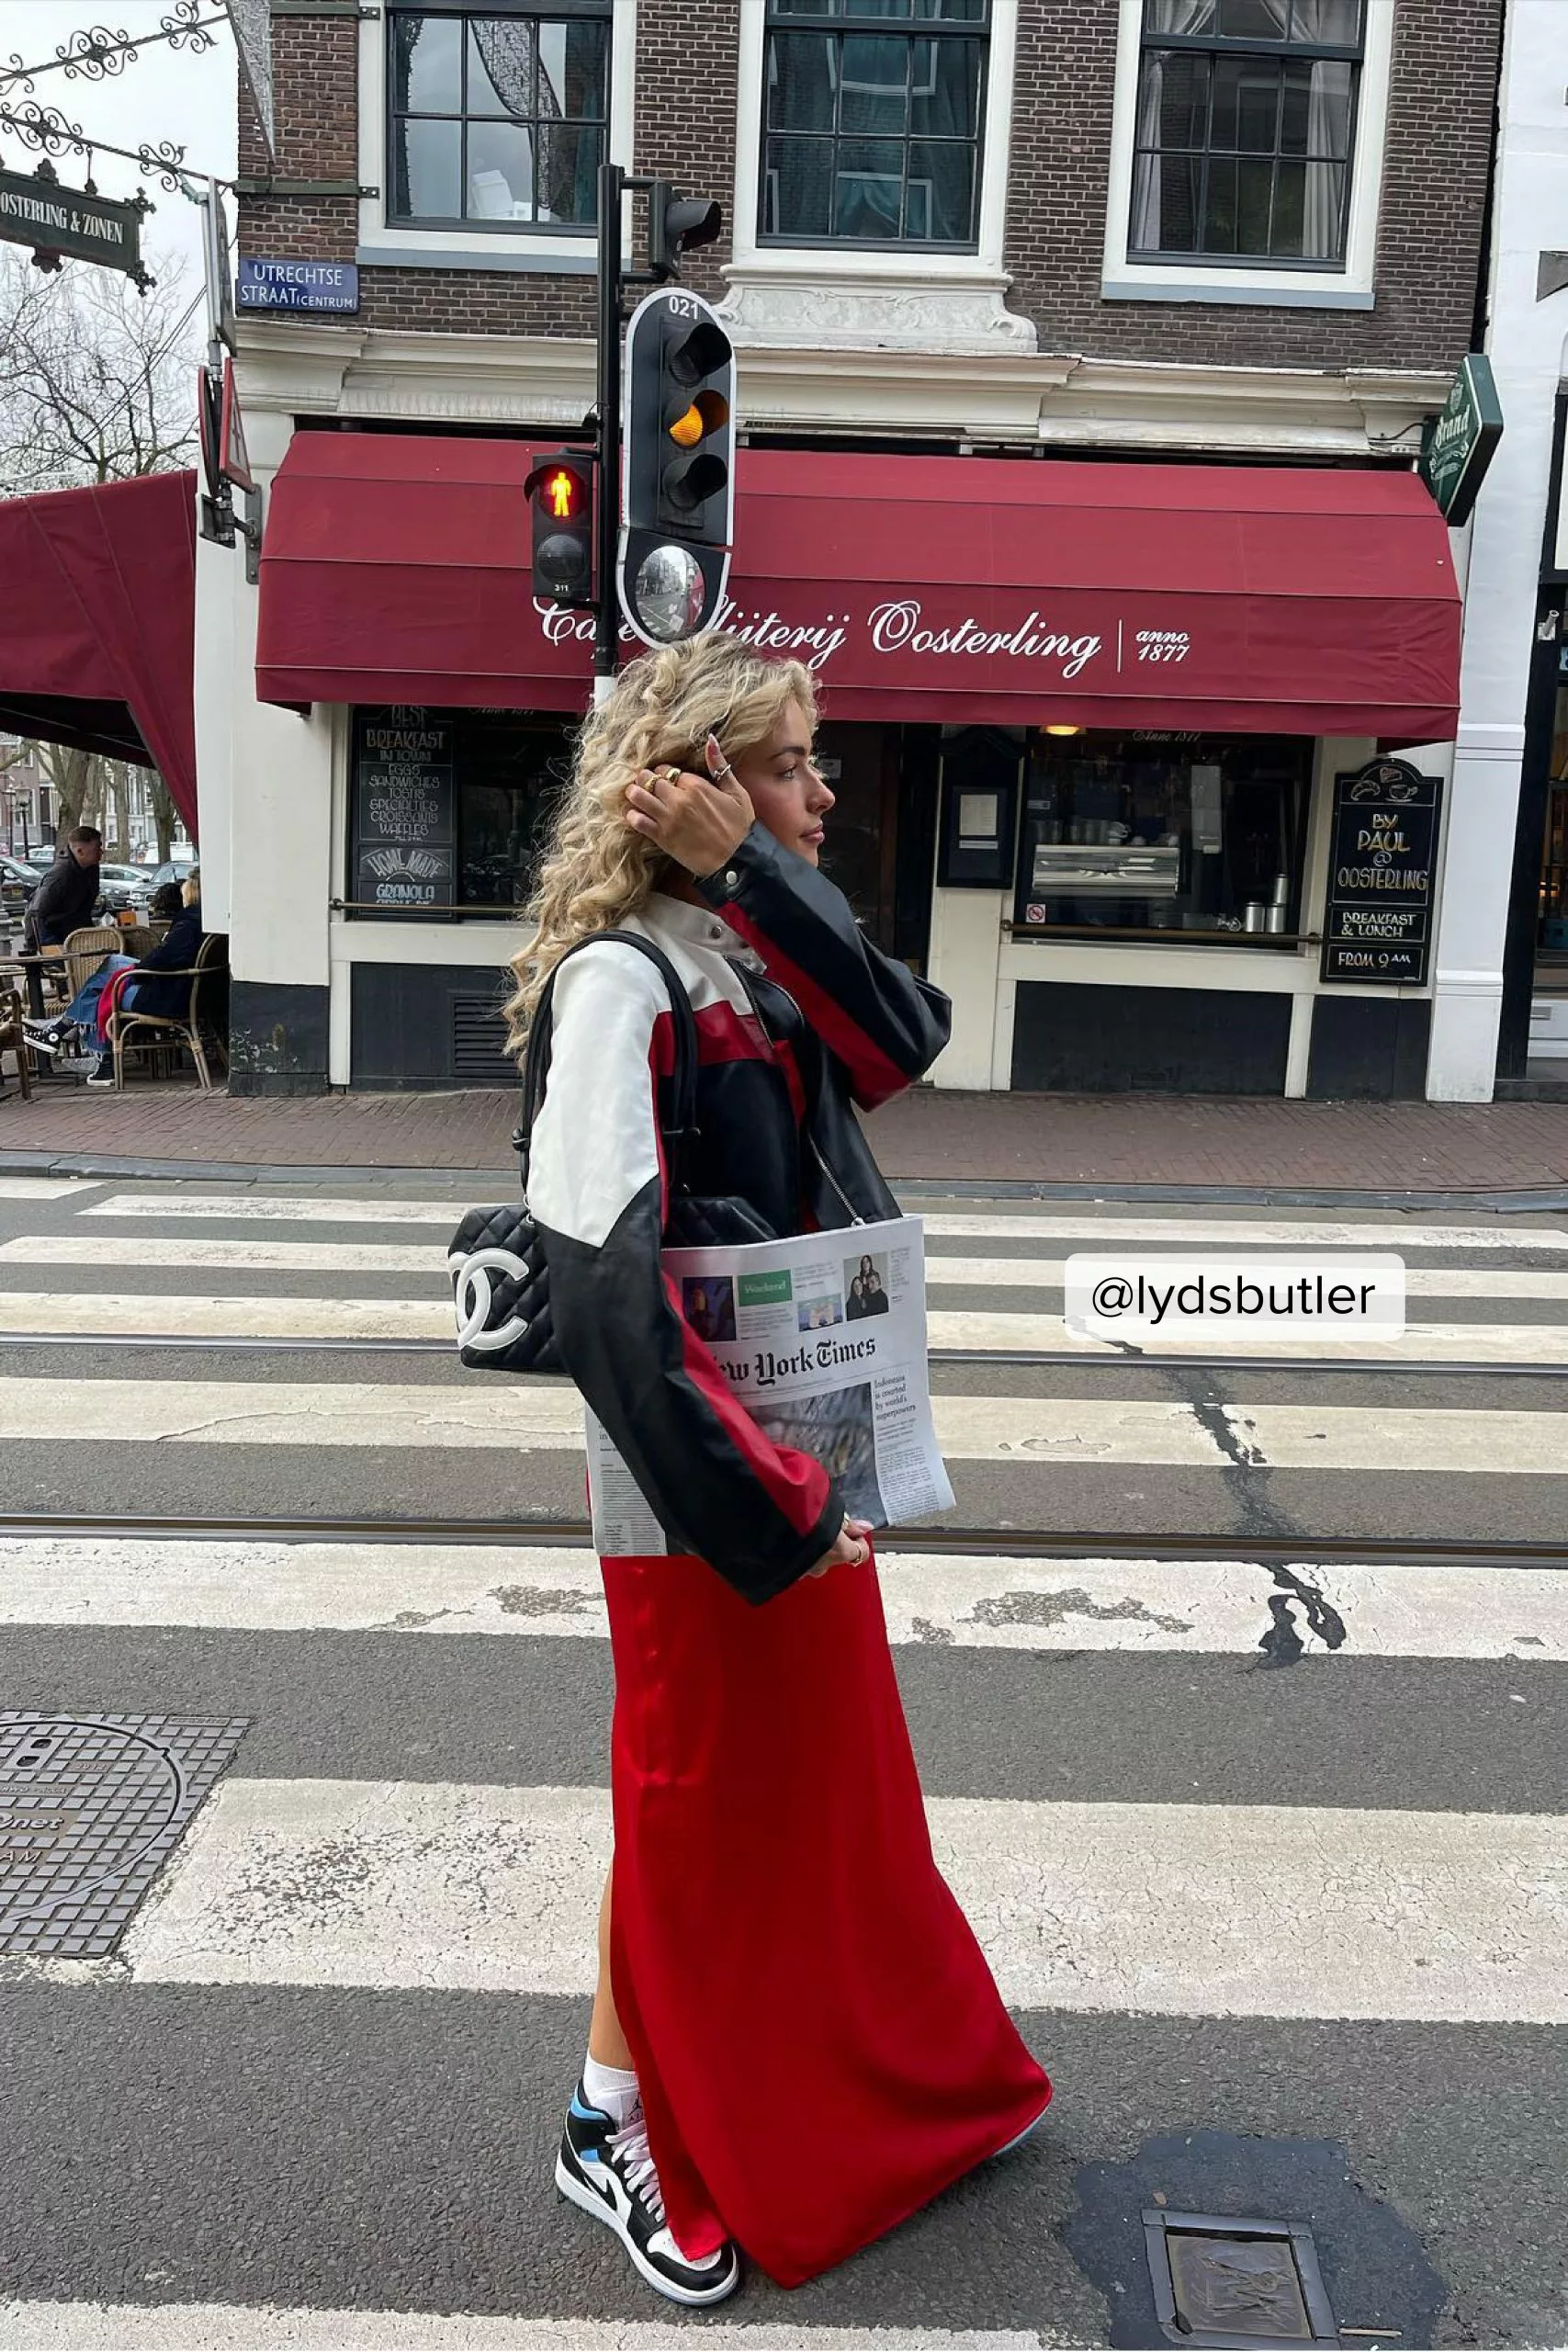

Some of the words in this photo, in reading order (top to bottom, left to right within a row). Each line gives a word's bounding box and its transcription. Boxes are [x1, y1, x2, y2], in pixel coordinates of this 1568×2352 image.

[70, 210, 81, 232] &
[83, 213, 123, 244] ZONEN
[254, 265, 343, 286] UTRECHTSE
[668, 296, 699, 320] 021
[554, 583, 569, 592] 311
[868, 600, 1102, 679] Oosterling
[1134, 630, 1190, 643] anno
[1137, 644, 1190, 662] 1877
[367, 729, 446, 750] BREAKFAST
[379, 750, 393, 762] IN
[389, 764, 421, 776] EGGS
[368, 775, 440, 788] SANDWICHES
[1372, 813, 1399, 829] BY
[1357, 830, 1411, 852] PAUL
[1373, 851, 1393, 867] @
[1337, 867, 1428, 891] OOSTERLING
[376, 883, 435, 899] GRANOLA
[1342, 911, 1417, 926] BREAKFAST
[1341, 924, 1354, 936] &
[1359, 925, 1404, 937] LUNCH
[1338, 952, 1374, 967] FROM
[1378, 953, 1389, 968] 9
[1391, 954, 1411, 964] AM
[755, 1346, 814, 1386] York
[816, 1337, 876, 1369] Times
